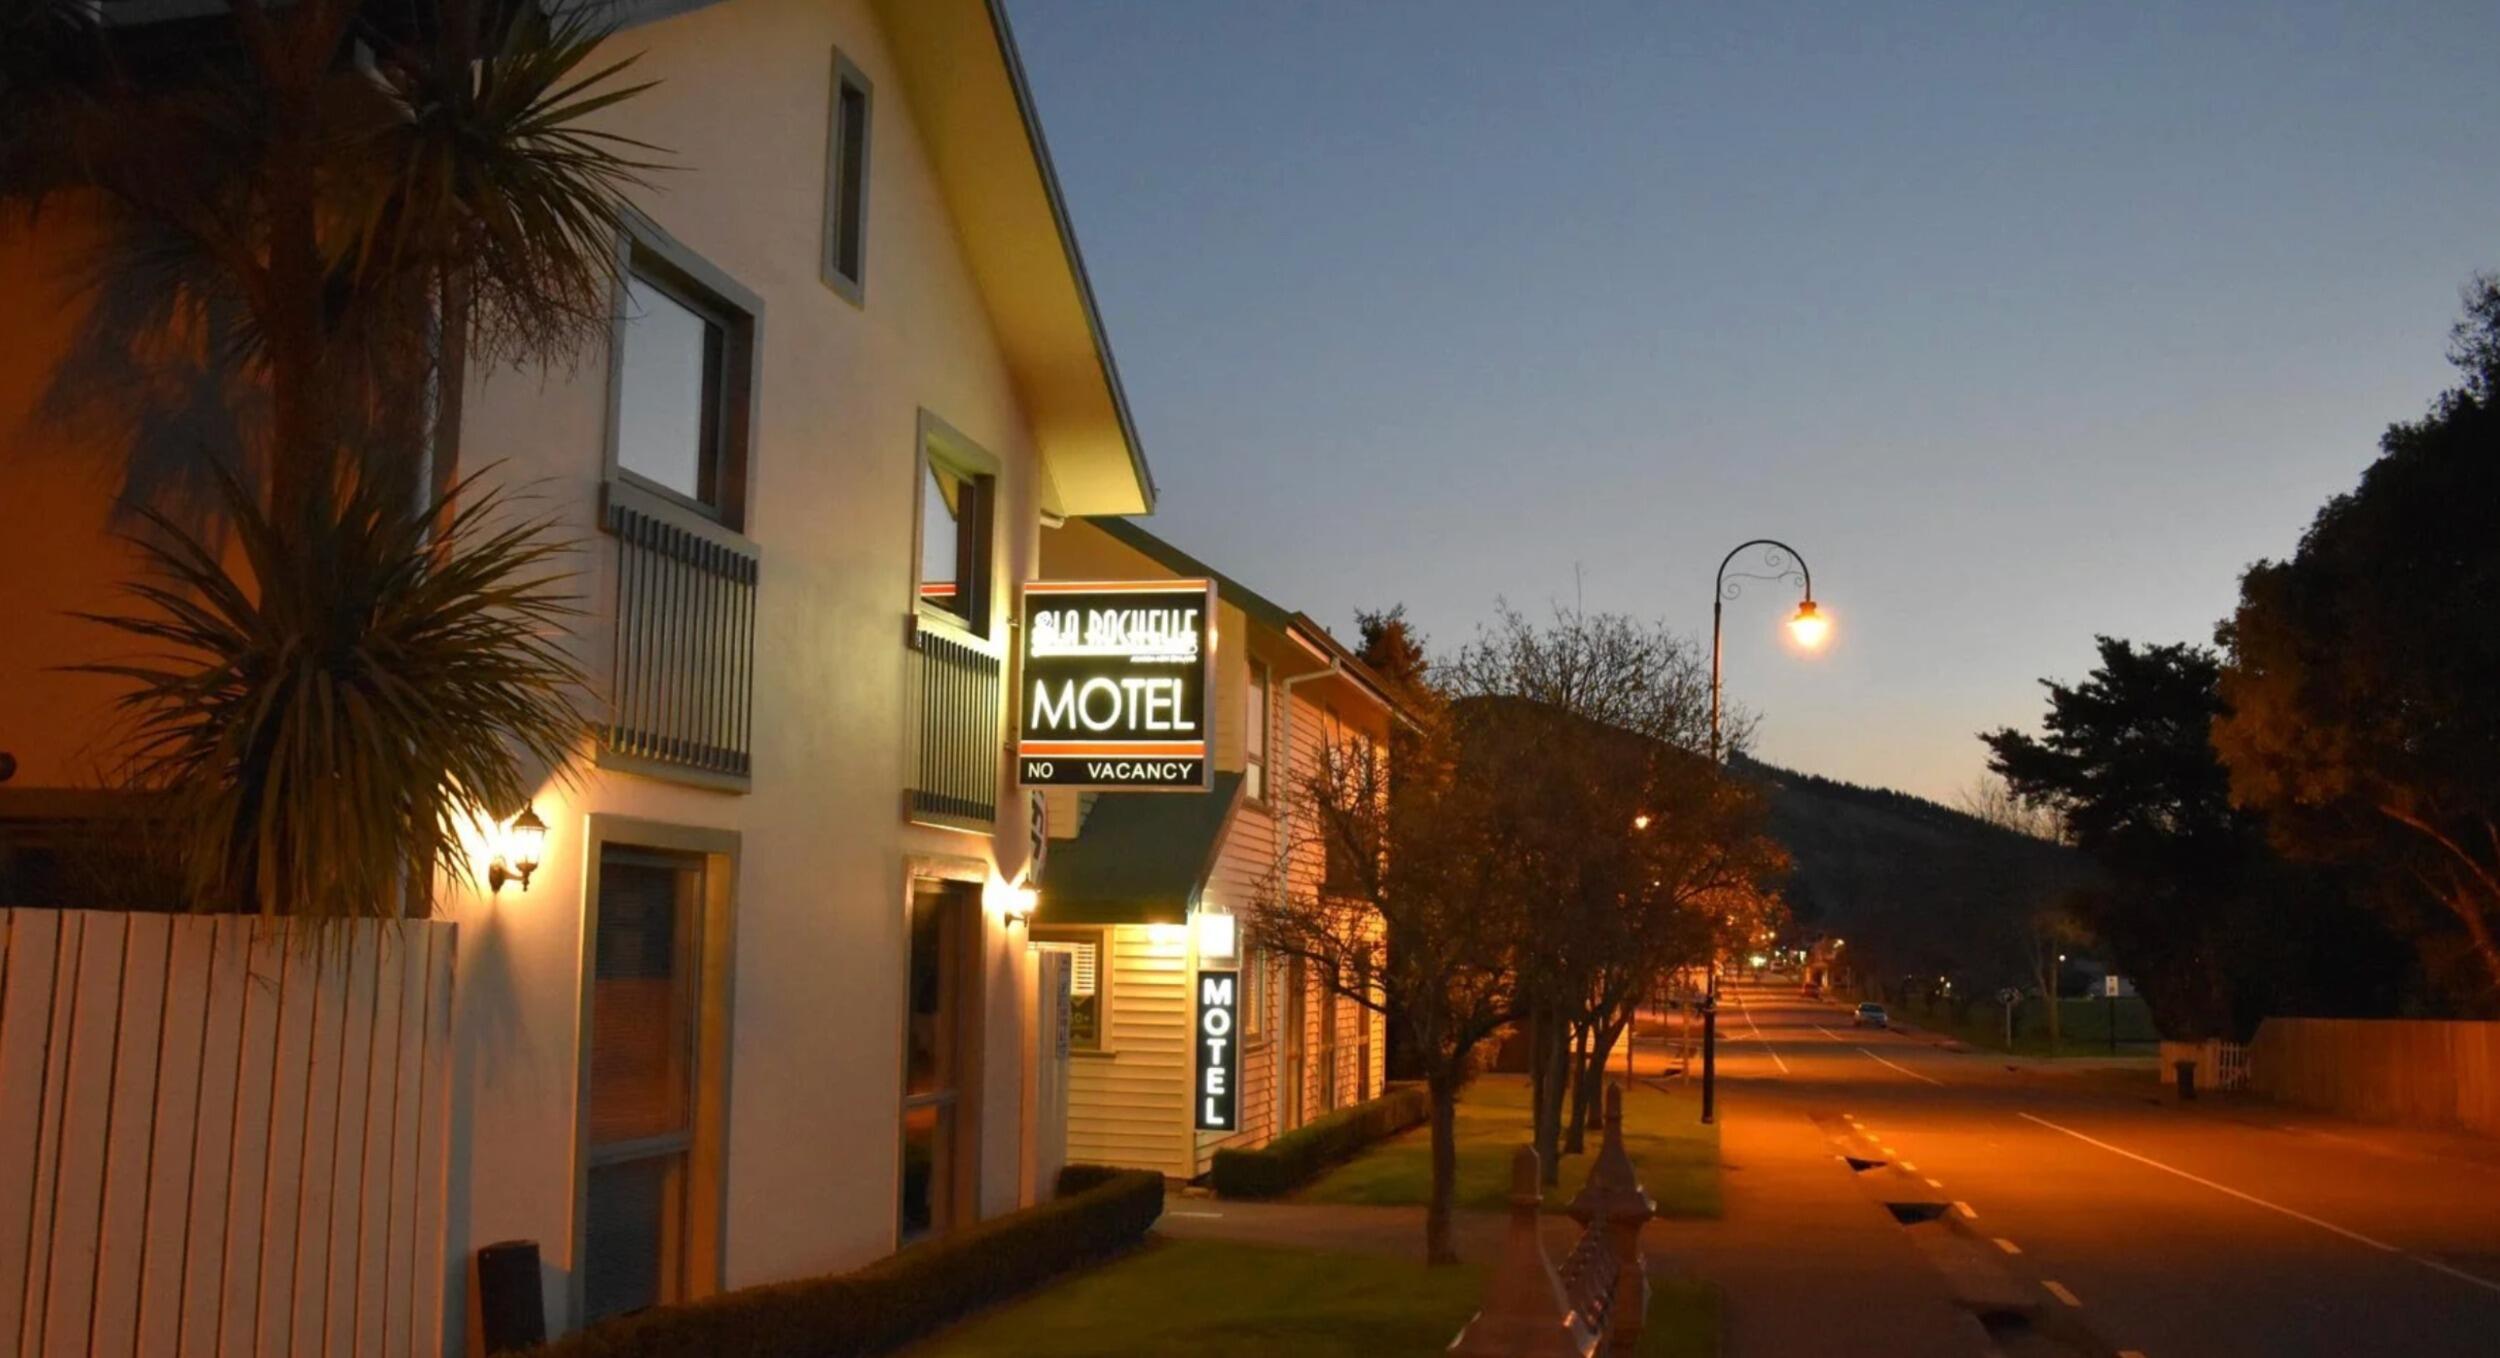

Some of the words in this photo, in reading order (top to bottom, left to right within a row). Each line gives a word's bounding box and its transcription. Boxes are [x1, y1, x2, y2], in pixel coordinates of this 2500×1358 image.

[1053, 609, 1080, 647] LA
[1084, 609, 1198, 649] ROCHELLE
[1031, 677, 1196, 731] MOTEL
[1028, 762, 1054, 778] NO
[1088, 762, 1193, 779] VACANCY
[1203, 978, 1232, 1125] MOTEL
